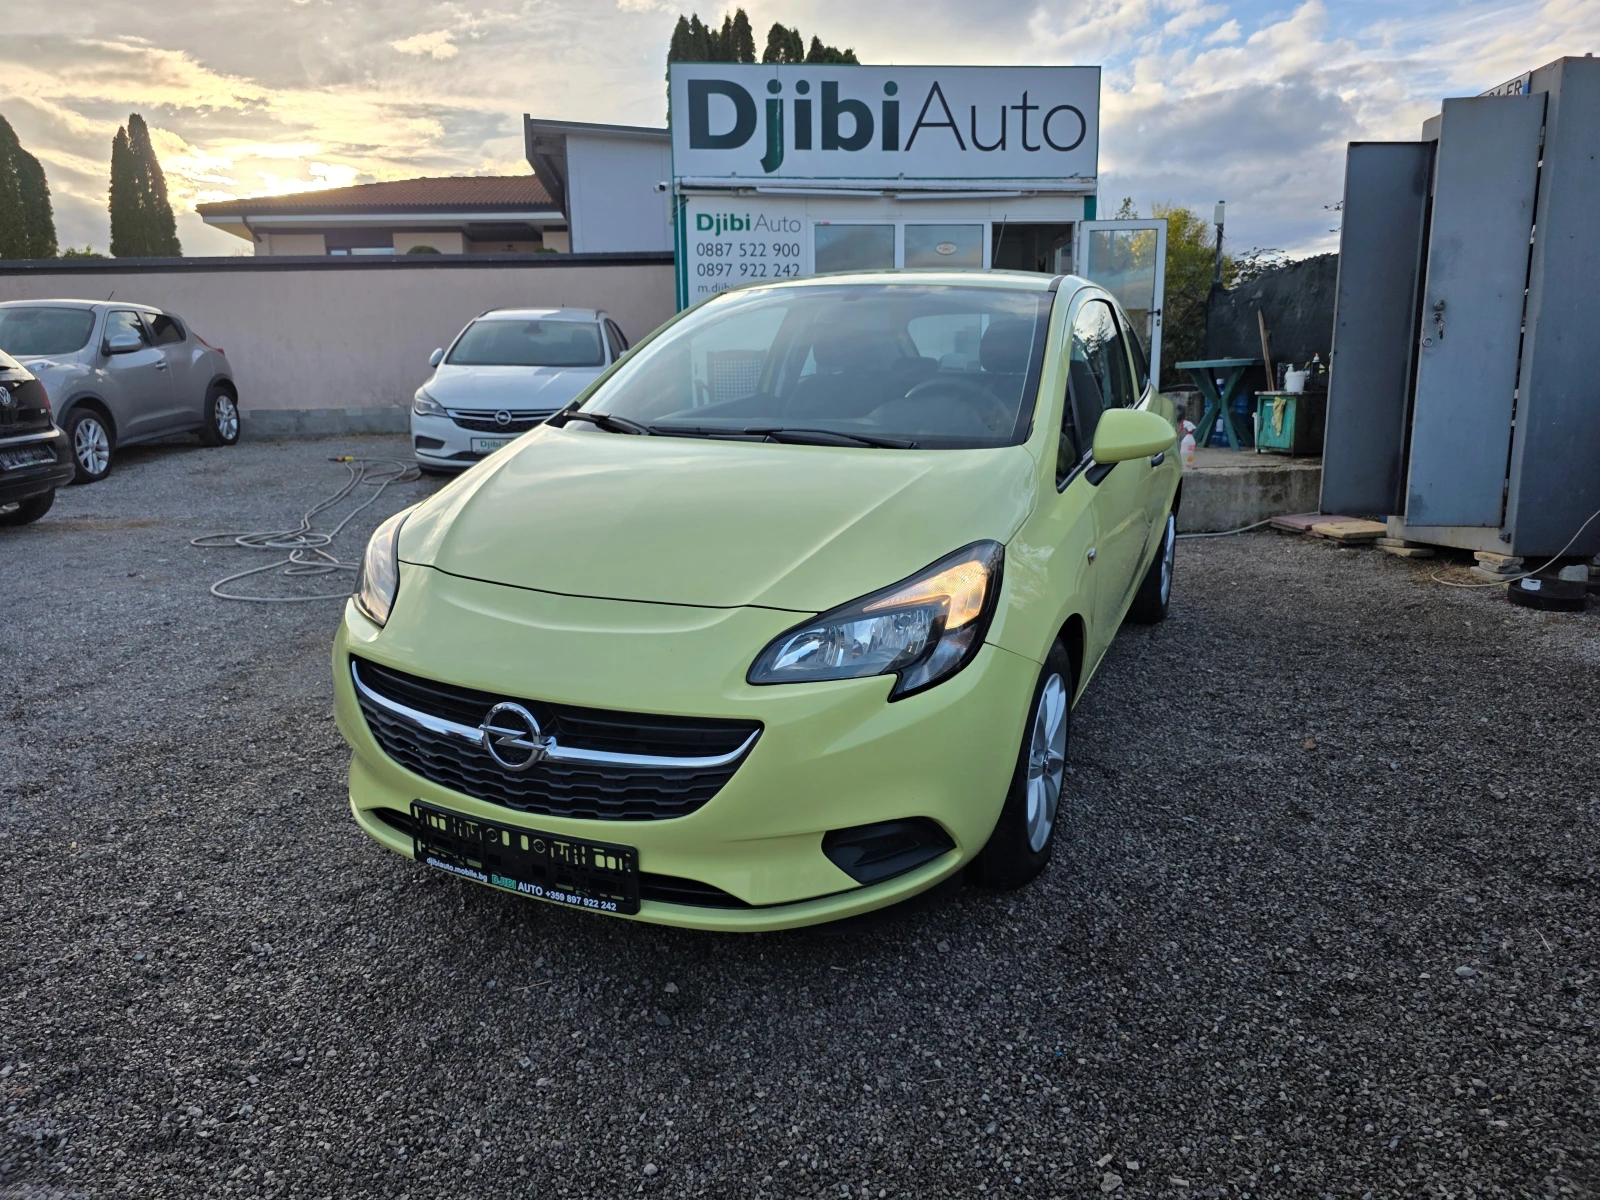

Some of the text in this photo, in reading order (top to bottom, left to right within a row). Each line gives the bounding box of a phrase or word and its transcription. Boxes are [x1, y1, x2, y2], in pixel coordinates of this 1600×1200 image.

[696, 213, 801, 236] Djibi Auto
[696, 243, 800, 257] 0887 522 900
[697, 263, 800, 277] 0897 922 242
[426, 857, 617, 911] djibiauto.mobile.bg DJIBI AUTO +359 897 922 242
